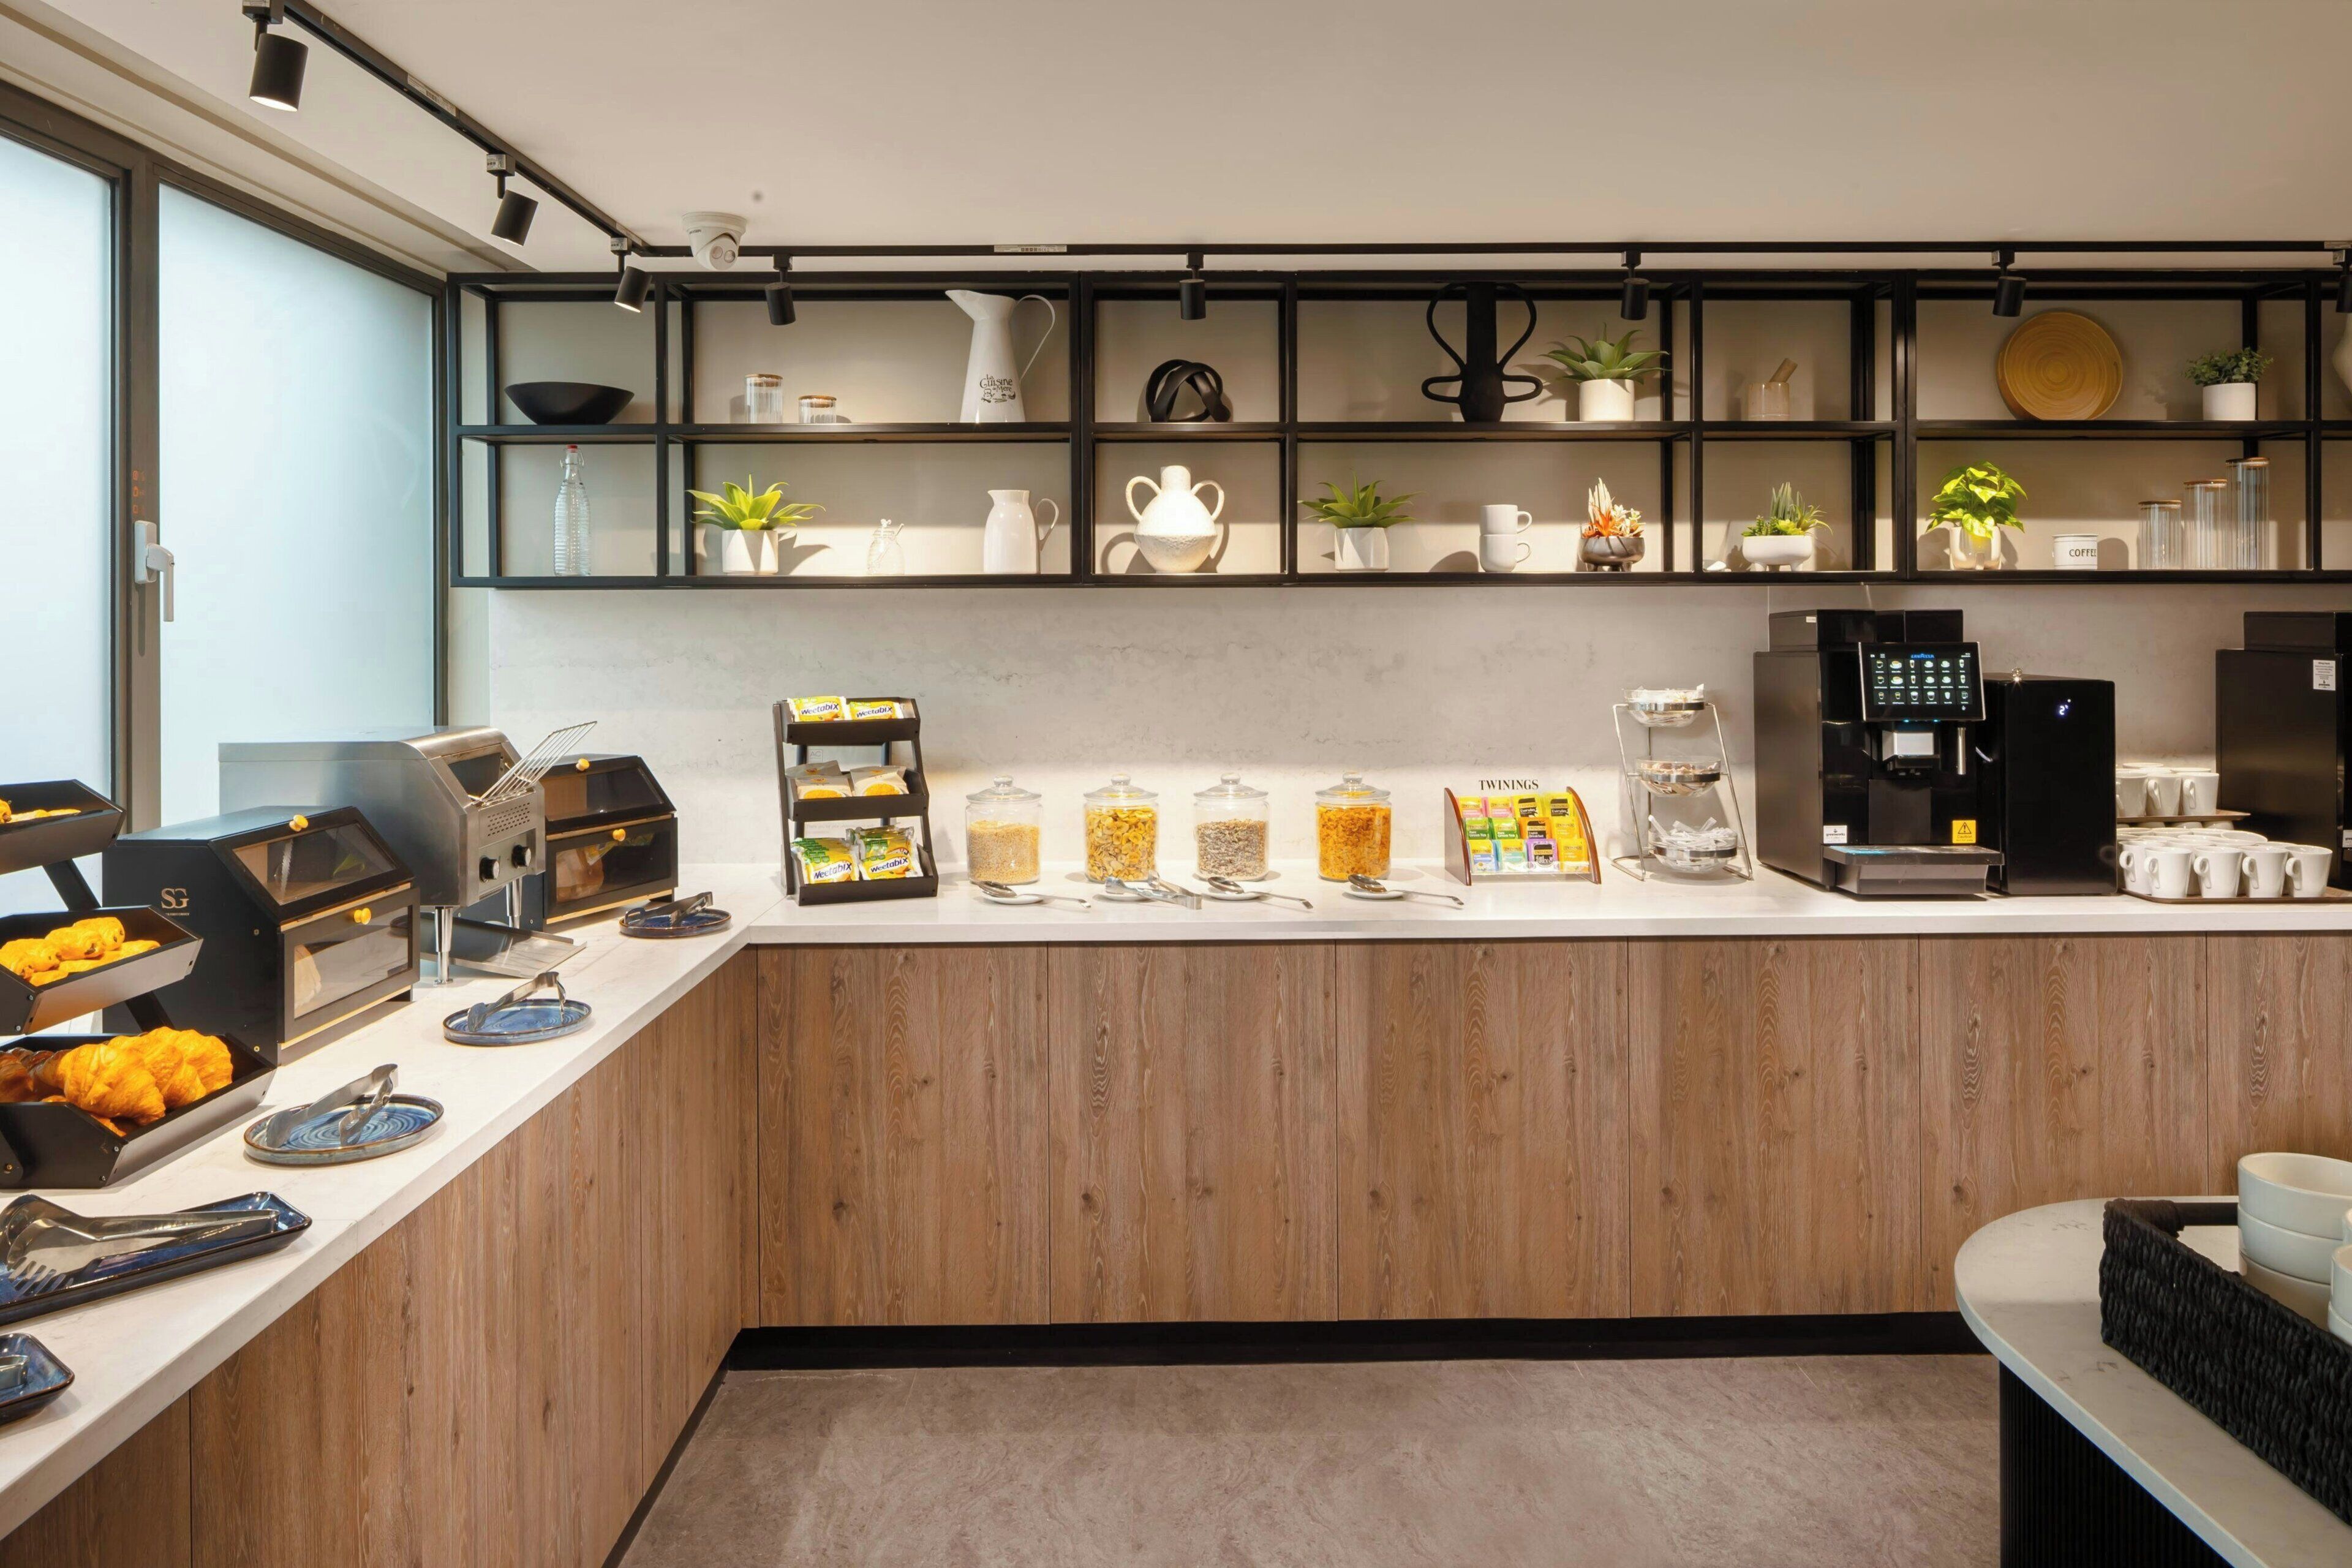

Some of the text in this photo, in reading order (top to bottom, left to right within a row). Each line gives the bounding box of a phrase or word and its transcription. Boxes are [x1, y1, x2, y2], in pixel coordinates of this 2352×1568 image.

[979, 378, 1013, 389] Cuisine
[801, 703, 839, 715] Weetabix
[856, 707, 892, 718] Weetabix
[1479, 779, 1539, 791] TWININGS
[870, 858, 908, 873] Weetabix
[161, 888, 189, 909] SG
